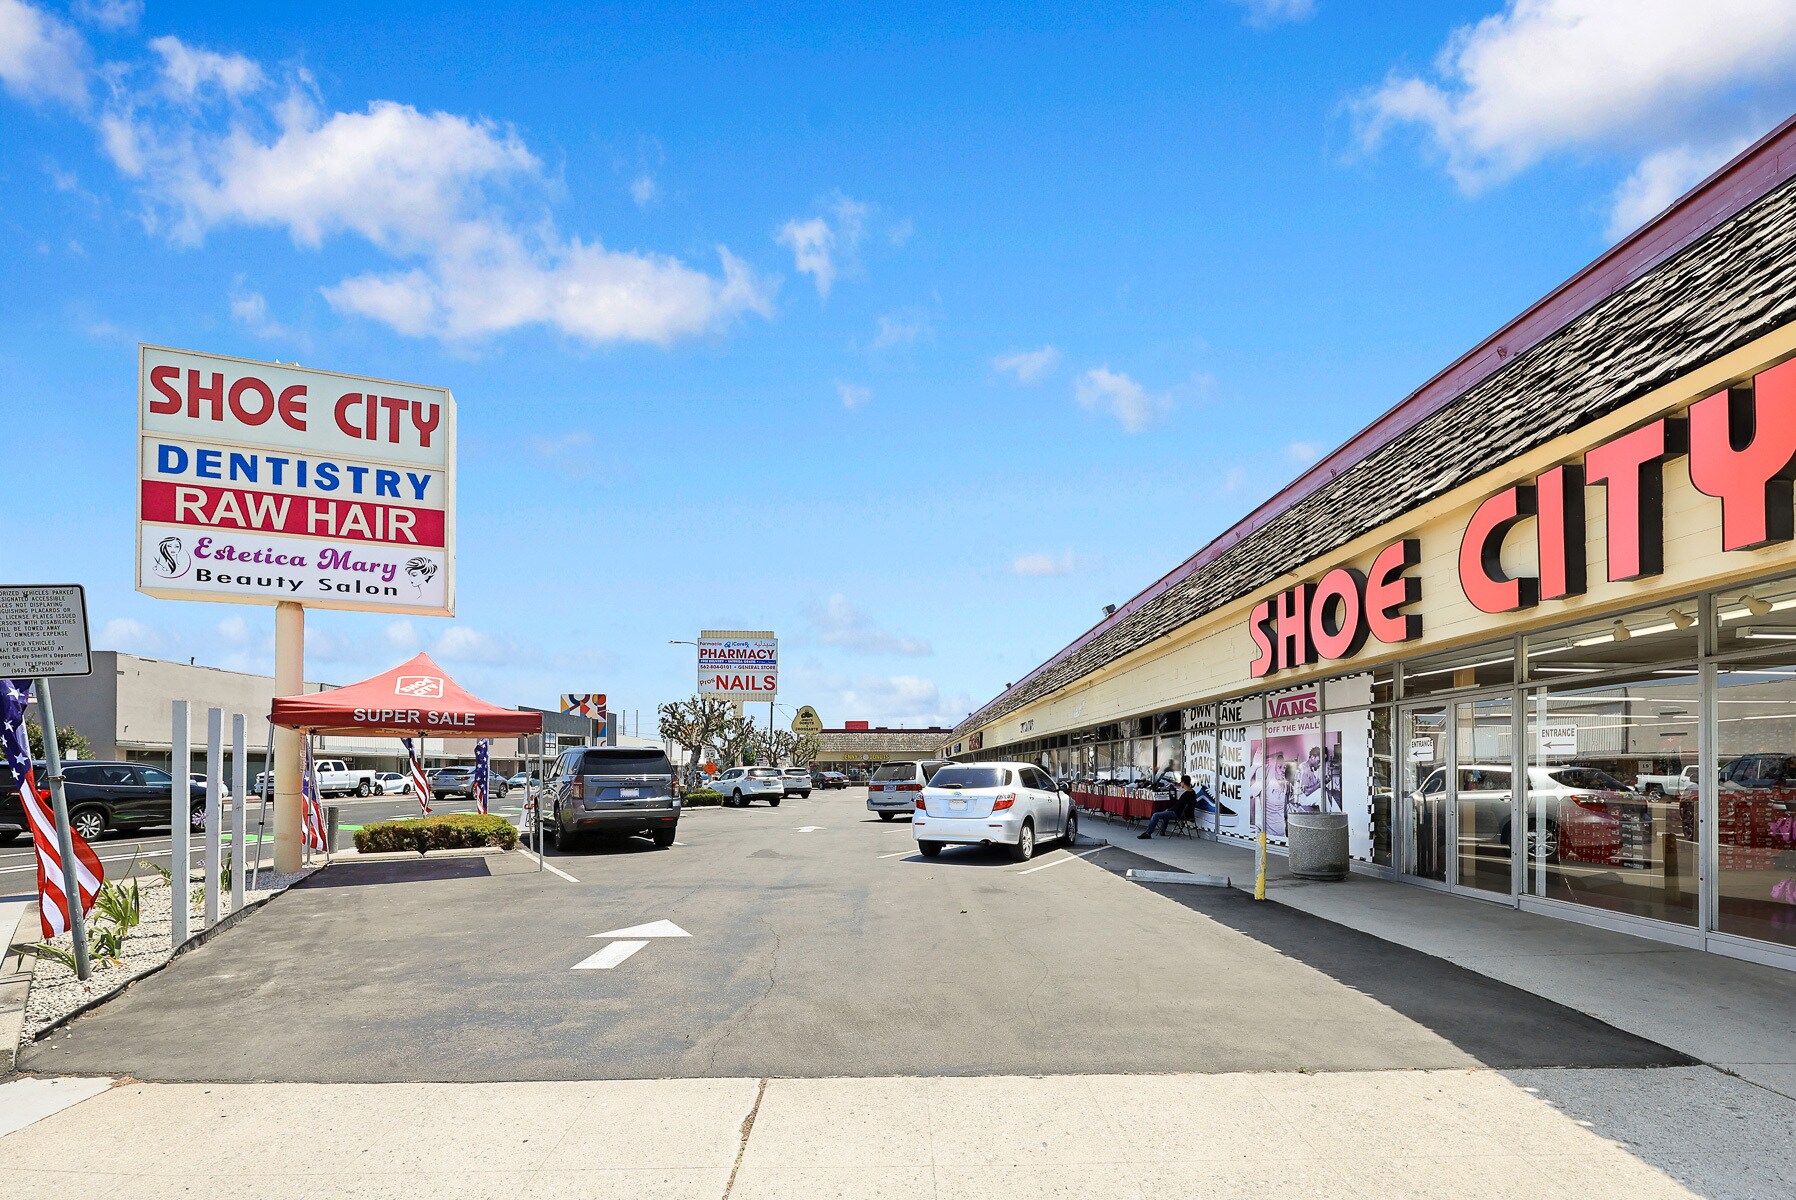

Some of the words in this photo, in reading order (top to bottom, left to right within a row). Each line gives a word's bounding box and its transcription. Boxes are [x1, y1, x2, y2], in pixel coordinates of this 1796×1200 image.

[150, 366, 307, 431] SHOE
[334, 393, 440, 447] CITY
[158, 444, 431, 500] DENTISTRY
[175, 486, 291, 530] RAW
[307, 499, 418, 542] HAIR
[1249, 539, 1421, 678] SHOE
[1458, 358, 1796, 614] CITY
[194, 537, 307, 566] Estetica
[317, 548, 397, 582] Mary
[196, 569, 304, 591] Beauty
[319, 578, 398, 596] Salon
[700, 649, 774, 659] PHARMACY
[716, 675, 776, 690] NAILS
[353, 708, 420, 724] SUPER
[427, 710, 476, 726] SALE
[1191, 705, 1210, 721] OWN
[1220, 706, 1242, 722] ANE
[1268, 692, 1318, 723] VANS
[1541, 728, 1575, 738] ENTRANCE
[1191, 740, 1210, 756] OWN
[1220, 746, 1242, 762] ANE
[1411, 739, 1433, 748] ENTRANCE
[1190, 756, 1215, 772] MAKE
[1220, 781, 1241, 800] ANE
